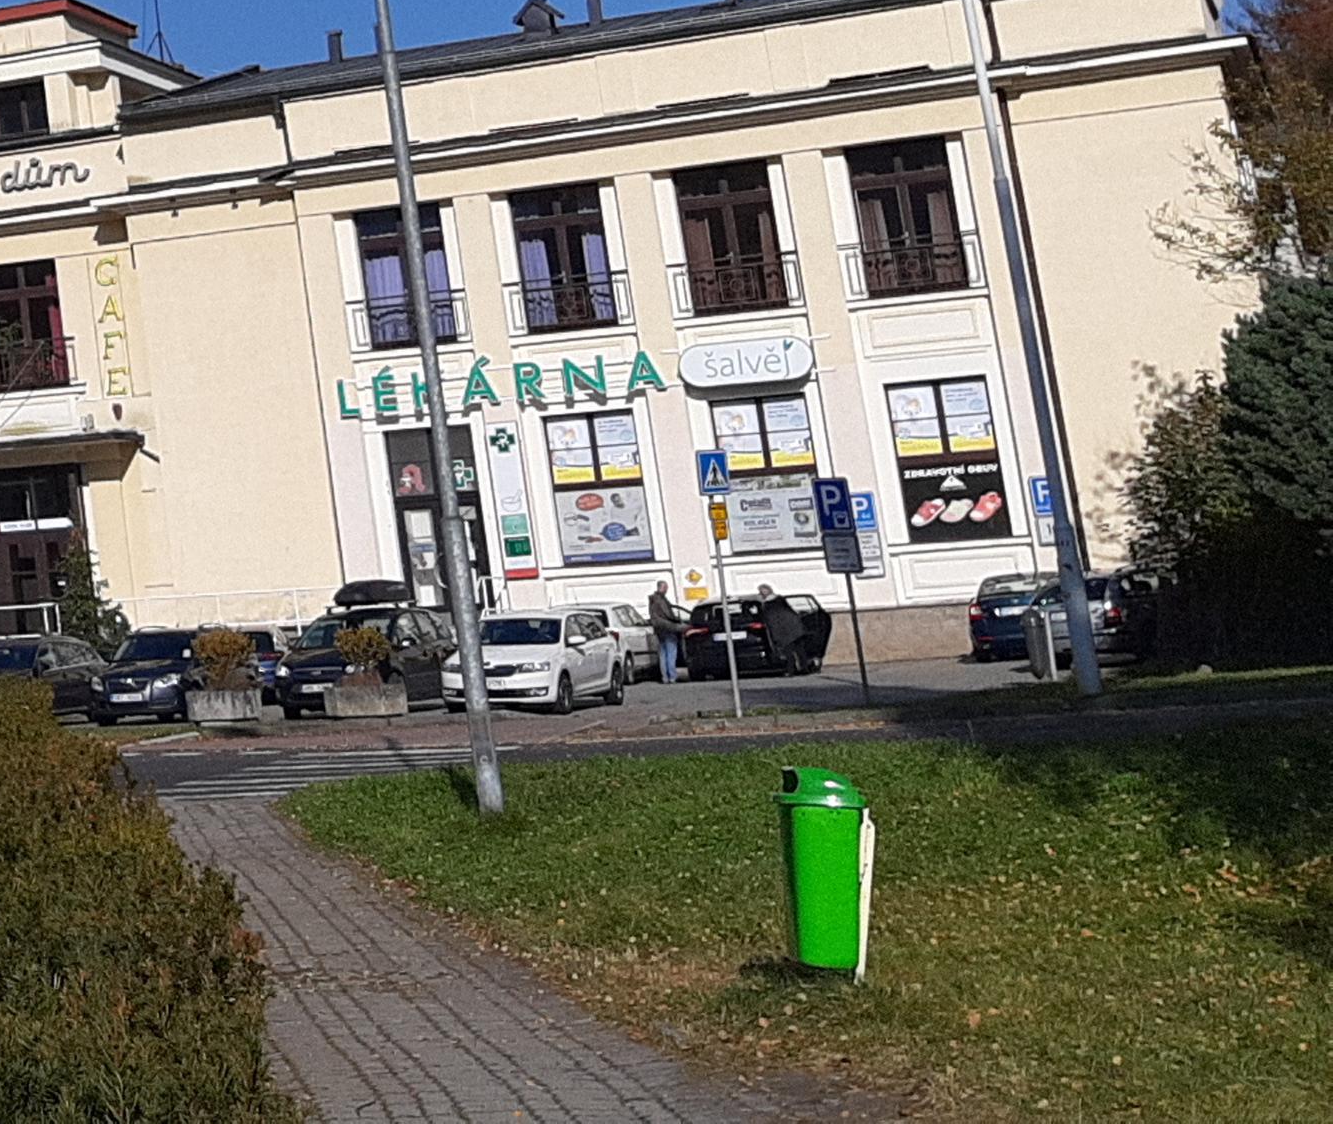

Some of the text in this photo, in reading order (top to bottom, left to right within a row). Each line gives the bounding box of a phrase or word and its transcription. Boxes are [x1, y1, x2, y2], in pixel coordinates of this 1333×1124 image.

[0, 157, 90, 193] dům
[704, 339, 793, 379] šalvěj
[820, 485, 841, 516] P
